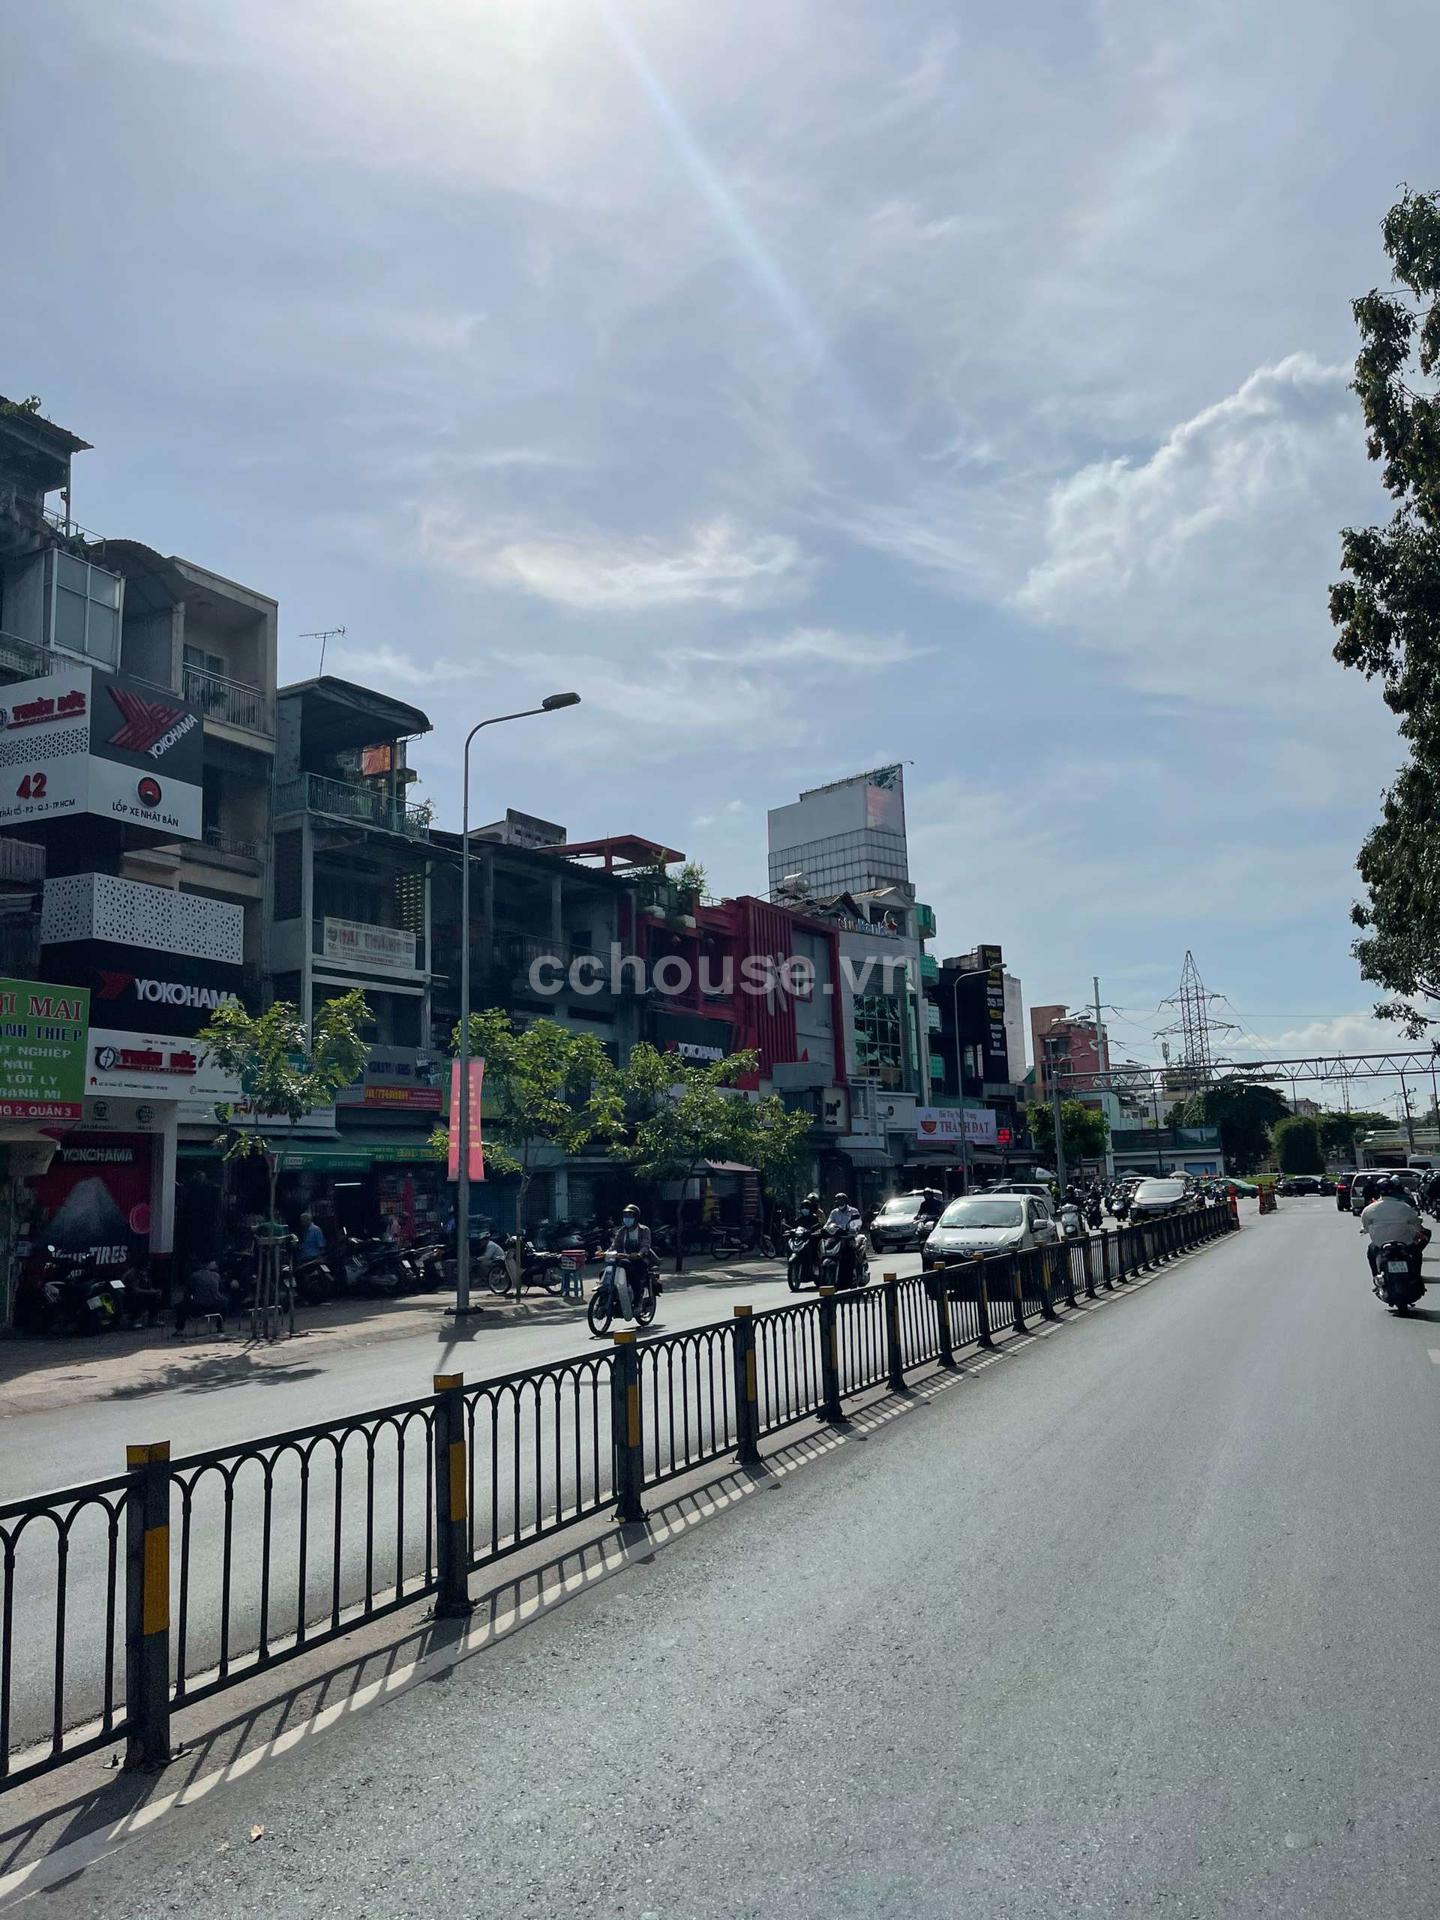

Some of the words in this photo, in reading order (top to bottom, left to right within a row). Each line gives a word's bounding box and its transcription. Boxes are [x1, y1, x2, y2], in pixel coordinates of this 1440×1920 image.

[148, 713, 199, 759] YOKOHAMA
[16, 772, 47, 799] 42
[112, 799, 128, 812] LỐP
[129, 806, 140, 817] XE
[135, 978, 240, 1010] YOKOHAMA
[28, 995, 82, 1022] MAI
[0, 1024, 27, 1038] NH
[3, 1059, 36, 1070] NAIL
[65, 1107, 73, 1117] 3
[62, 1147, 136, 1163] YOKOHAMA
